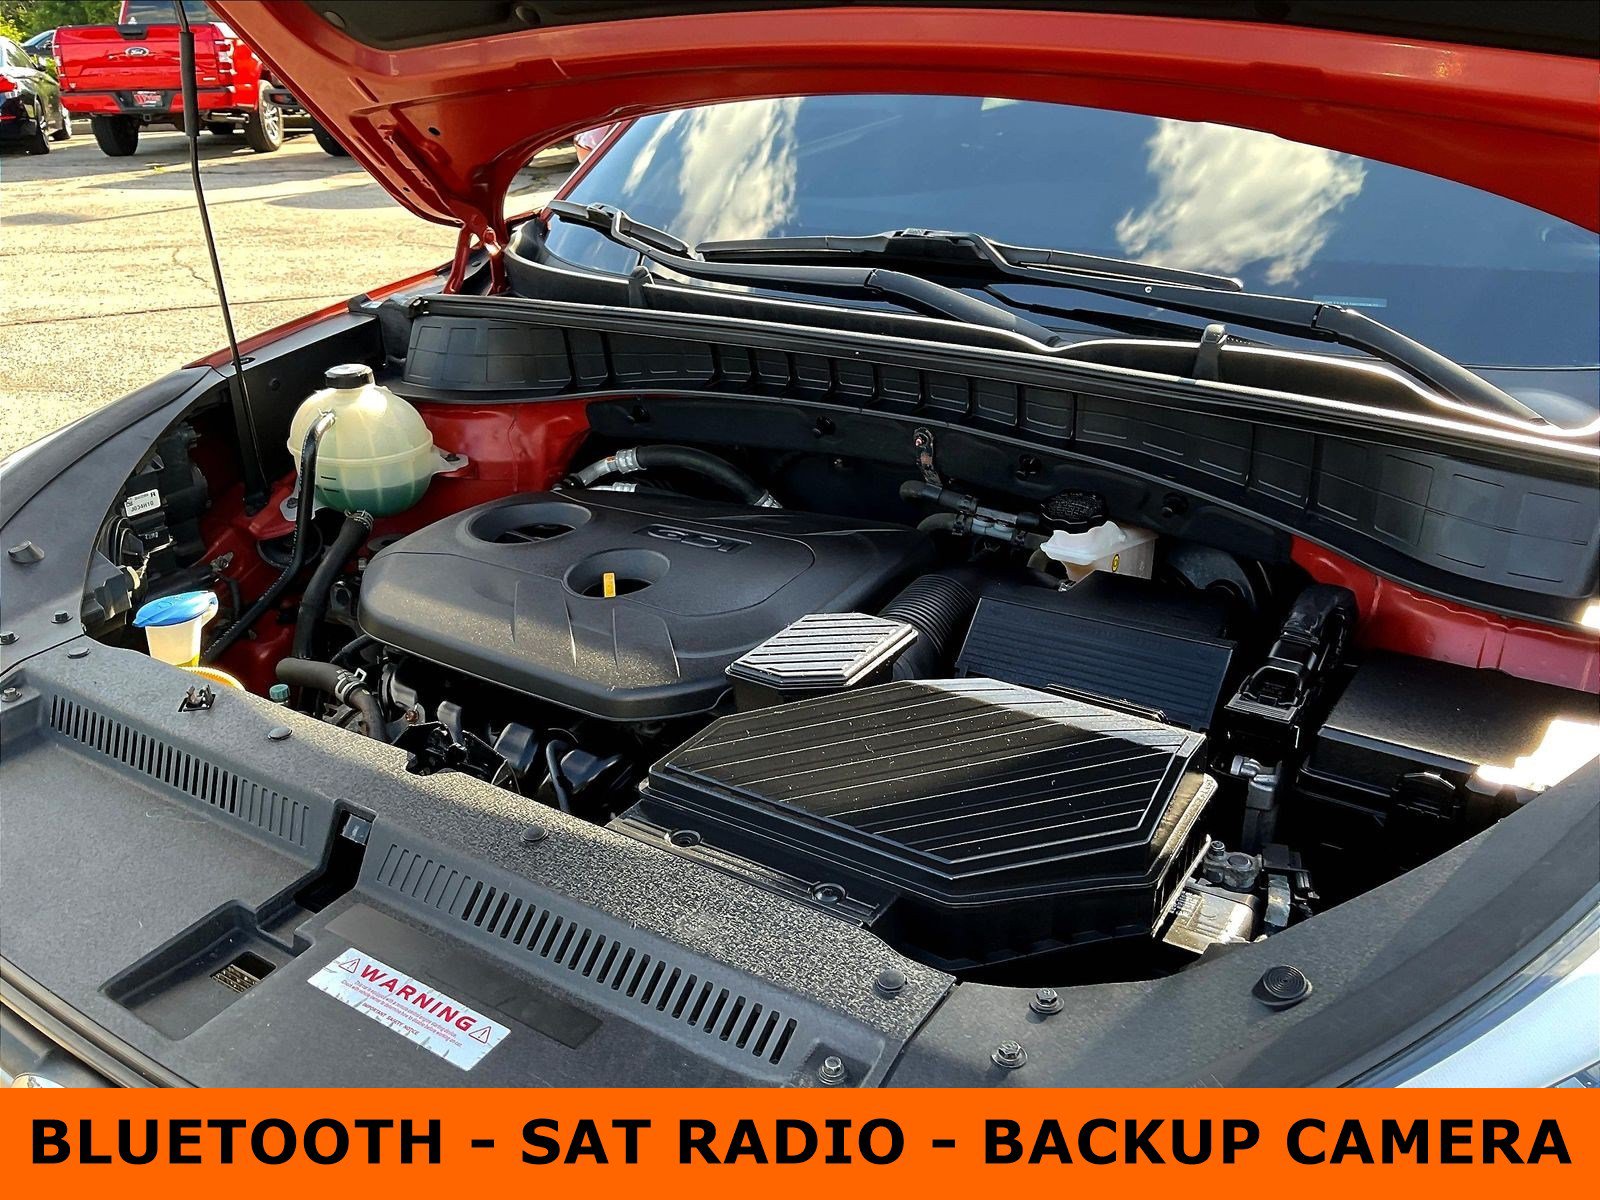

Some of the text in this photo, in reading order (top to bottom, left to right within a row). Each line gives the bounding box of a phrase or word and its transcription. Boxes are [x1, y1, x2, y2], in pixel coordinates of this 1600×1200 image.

[360, 964, 478, 1032] WARNING
[361, 1002, 419, 1035] IMPORTANT SAFETY NOTICE
